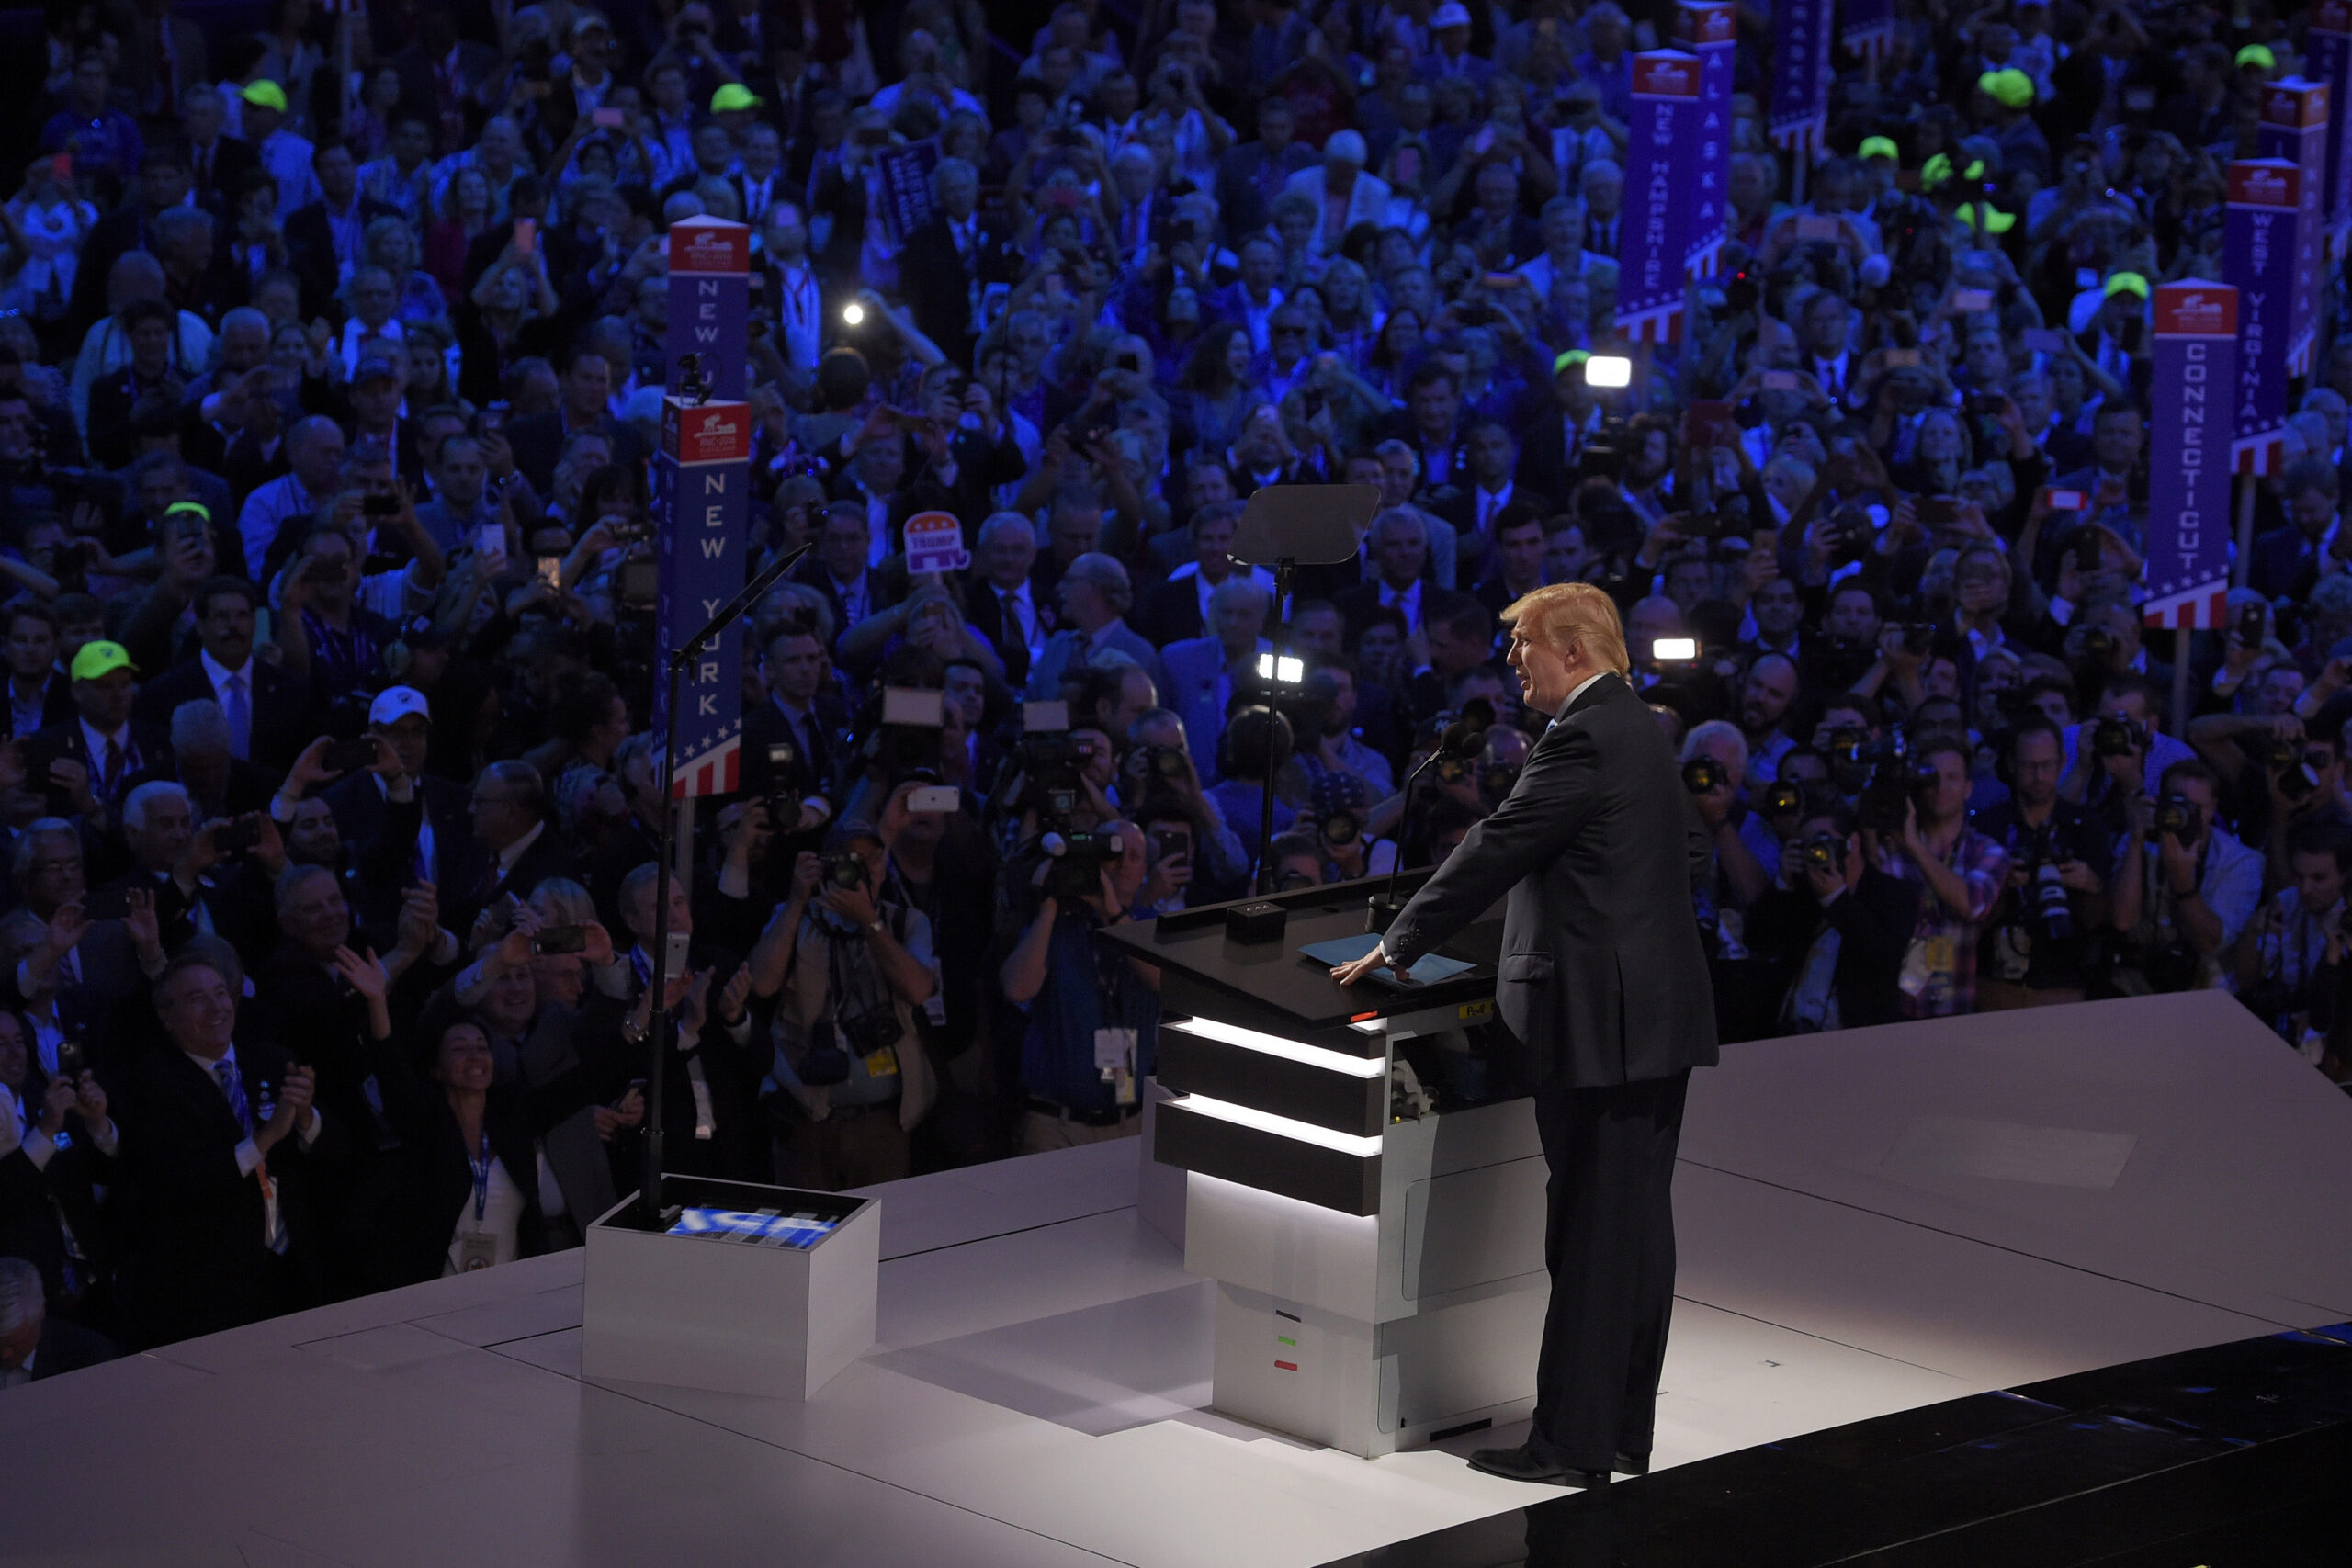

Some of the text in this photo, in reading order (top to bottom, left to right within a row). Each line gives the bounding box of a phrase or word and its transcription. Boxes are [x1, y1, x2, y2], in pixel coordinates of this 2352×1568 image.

[1652, 103, 1675, 147] NEW
[1700, 51, 1724, 219] ALASKA
[1644, 160, 1669, 289] HAMPSHIRE
[2252, 212, 2274, 276] WEST
[695, 279, 719, 343] NEW
[2240, 292, 2266, 417] VIRGINIA
[2177, 343, 2208, 570] CONNECTICUT
[700, 472, 726, 559] NEW
